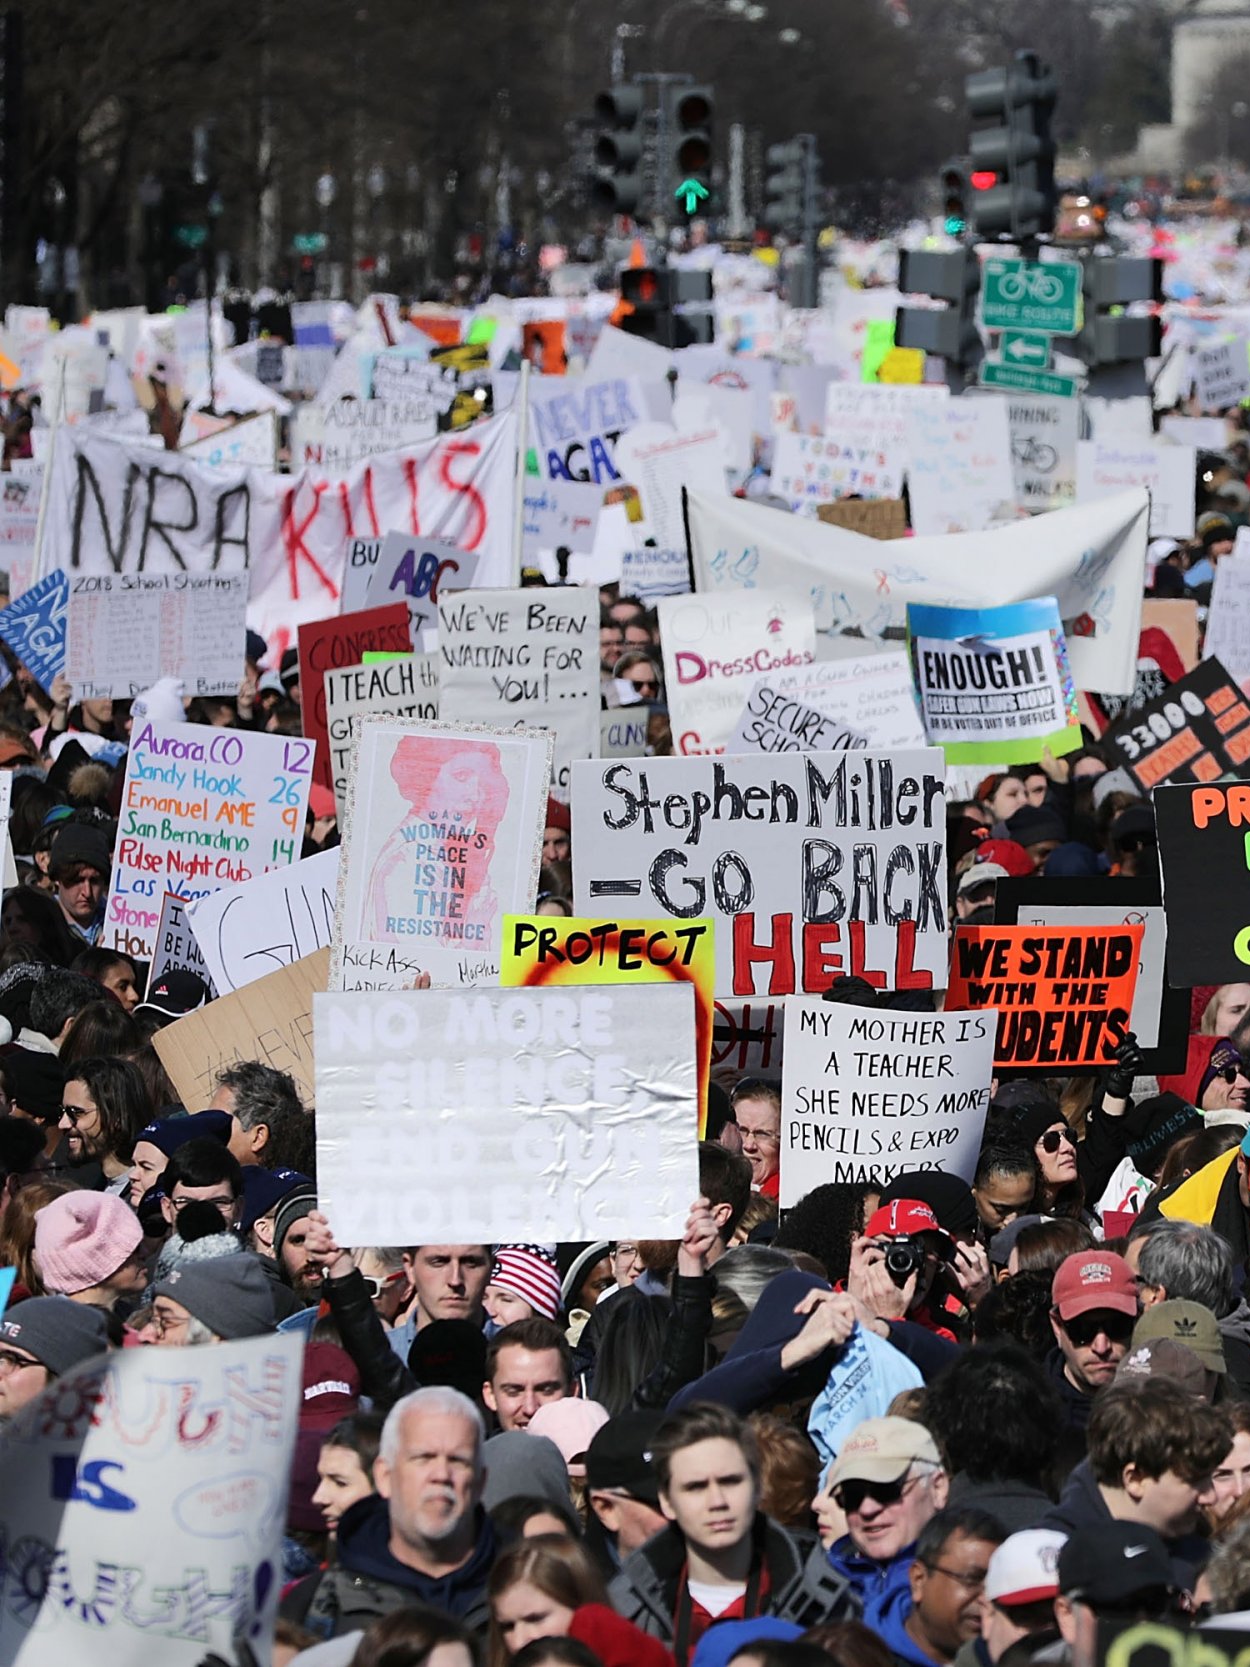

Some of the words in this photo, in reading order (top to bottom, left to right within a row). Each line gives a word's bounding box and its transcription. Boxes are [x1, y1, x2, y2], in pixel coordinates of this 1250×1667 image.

[528, 378, 639, 447] NEVER
[71, 451, 250, 573] NRA
[72, 575, 113, 593] 2018
[119, 573, 170, 592] School
[173, 573, 242, 594] Shootings
[389, 547, 461, 606] ABC
[439, 603, 510, 637] WE'VE
[526, 603, 587, 637] BEEN
[442, 643, 531, 671] WAITING
[542, 645, 583, 672] FOR
[922, 645, 1048, 691] ENOUGH!
[328, 675, 336, 706] I
[340, 662, 416, 702] TEACH
[1017, 686, 1055, 709] NOW
[747, 686, 837, 749] SECURE
[1019, 707, 1057, 727] OFFICE
[283, 742, 311, 775] 12
[129, 753, 187, 792] Sandy
[193, 769, 247, 799] Hook
[267, 777, 302, 806] 26
[126, 782, 210, 823] Emanuel
[215, 800, 256, 828] AME
[281, 807, 299, 834] 9
[602, 762, 799, 845] Stephen
[803, 753, 945, 831] Miller
[121, 810, 162, 841] San
[163, 819, 250, 854] Bernardino
[271, 839, 296, 865] 14
[399, 822, 489, 850] WOMAN'S
[415, 843, 469, 866] PLACE
[118, 839, 164, 872] Pulse
[166, 850, 211, 880] Night
[214, 852, 253, 883] Club
[414, 863, 439, 890] IS
[442, 864, 466, 891] IN
[114, 868, 157, 898] Las
[801, 838, 945, 934] BACK
[413, 888, 465, 920] THE
[164, 931, 184, 957] BE
[385, 916, 487, 942] RESISTANCE
[513, 922, 708, 972] PROTECT
[341, 944, 385, 969] Kick
[385, 949, 423, 976] Ass
[731, 912, 934, 996] HELL
[957, 936, 1009, 979] WE
[1018, 935, 1134, 979] STAND
[967, 982, 1037, 1006] WITH
[1050, 982, 1110, 1006] THE
[328, 1002, 420, 1053] NO
[443, 993, 616, 1047] MORE
[800, 1009, 833, 1037] MY
[847, 1016, 946, 1046] MOTHER
[956, 1016, 987, 1043] IS
[824, 1051, 841, 1077] A
[795, 1086, 841, 1116] SHE
[851, 1091, 930, 1118] NEEDS
[934, 1086, 992, 1114] MORE
[349, 1124, 479, 1177] END
[511, 1120, 662, 1174] GUN
[789, 1120, 884, 1157] PENCILS
[887, 1130, 903, 1152] &
[909, 1127, 961, 1153] EXPO
